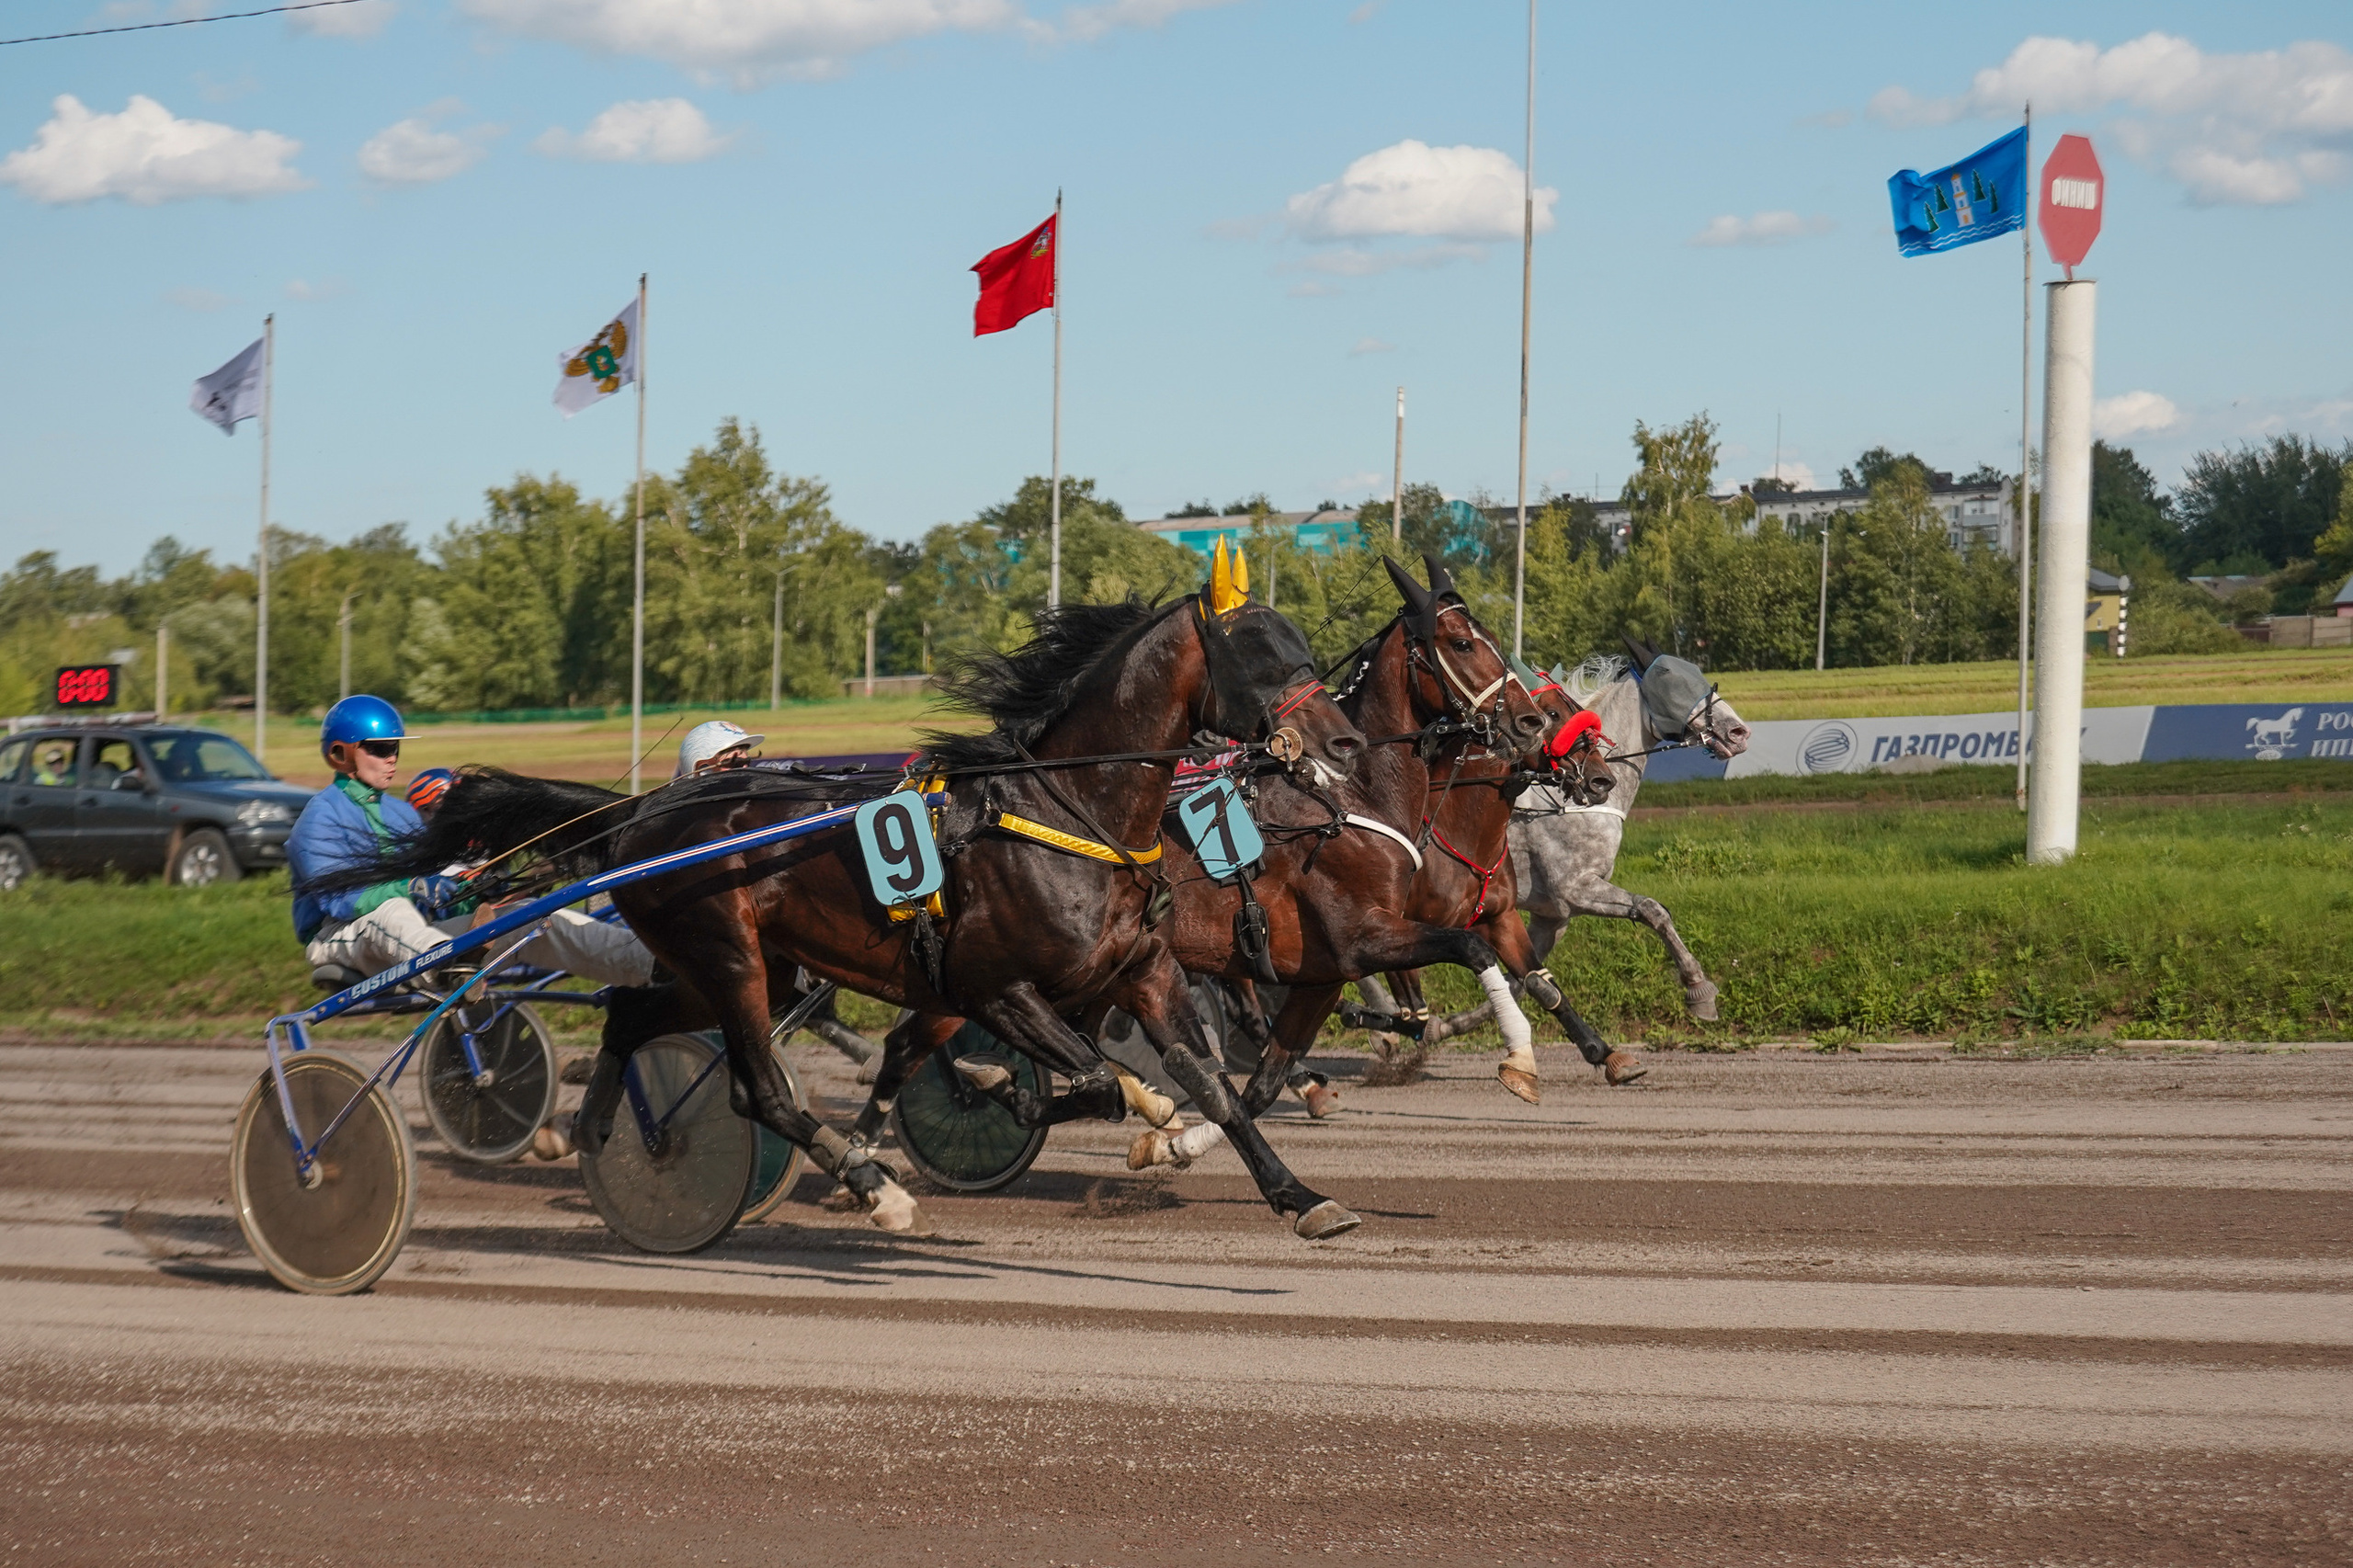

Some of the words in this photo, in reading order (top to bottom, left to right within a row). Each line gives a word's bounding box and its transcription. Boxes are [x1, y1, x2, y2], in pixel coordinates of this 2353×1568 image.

[1871, 727, 2087, 762] ГАЗПРОМБ
[2316, 712, 2353, 731] РО
[2311, 739, 2353, 756] ИП
[873, 803, 925, 892] 9
[1188, 786, 1240, 867] 7
[350, 960, 411, 999] CUSTOM
[415, 942, 454, 970] FLEXURE
